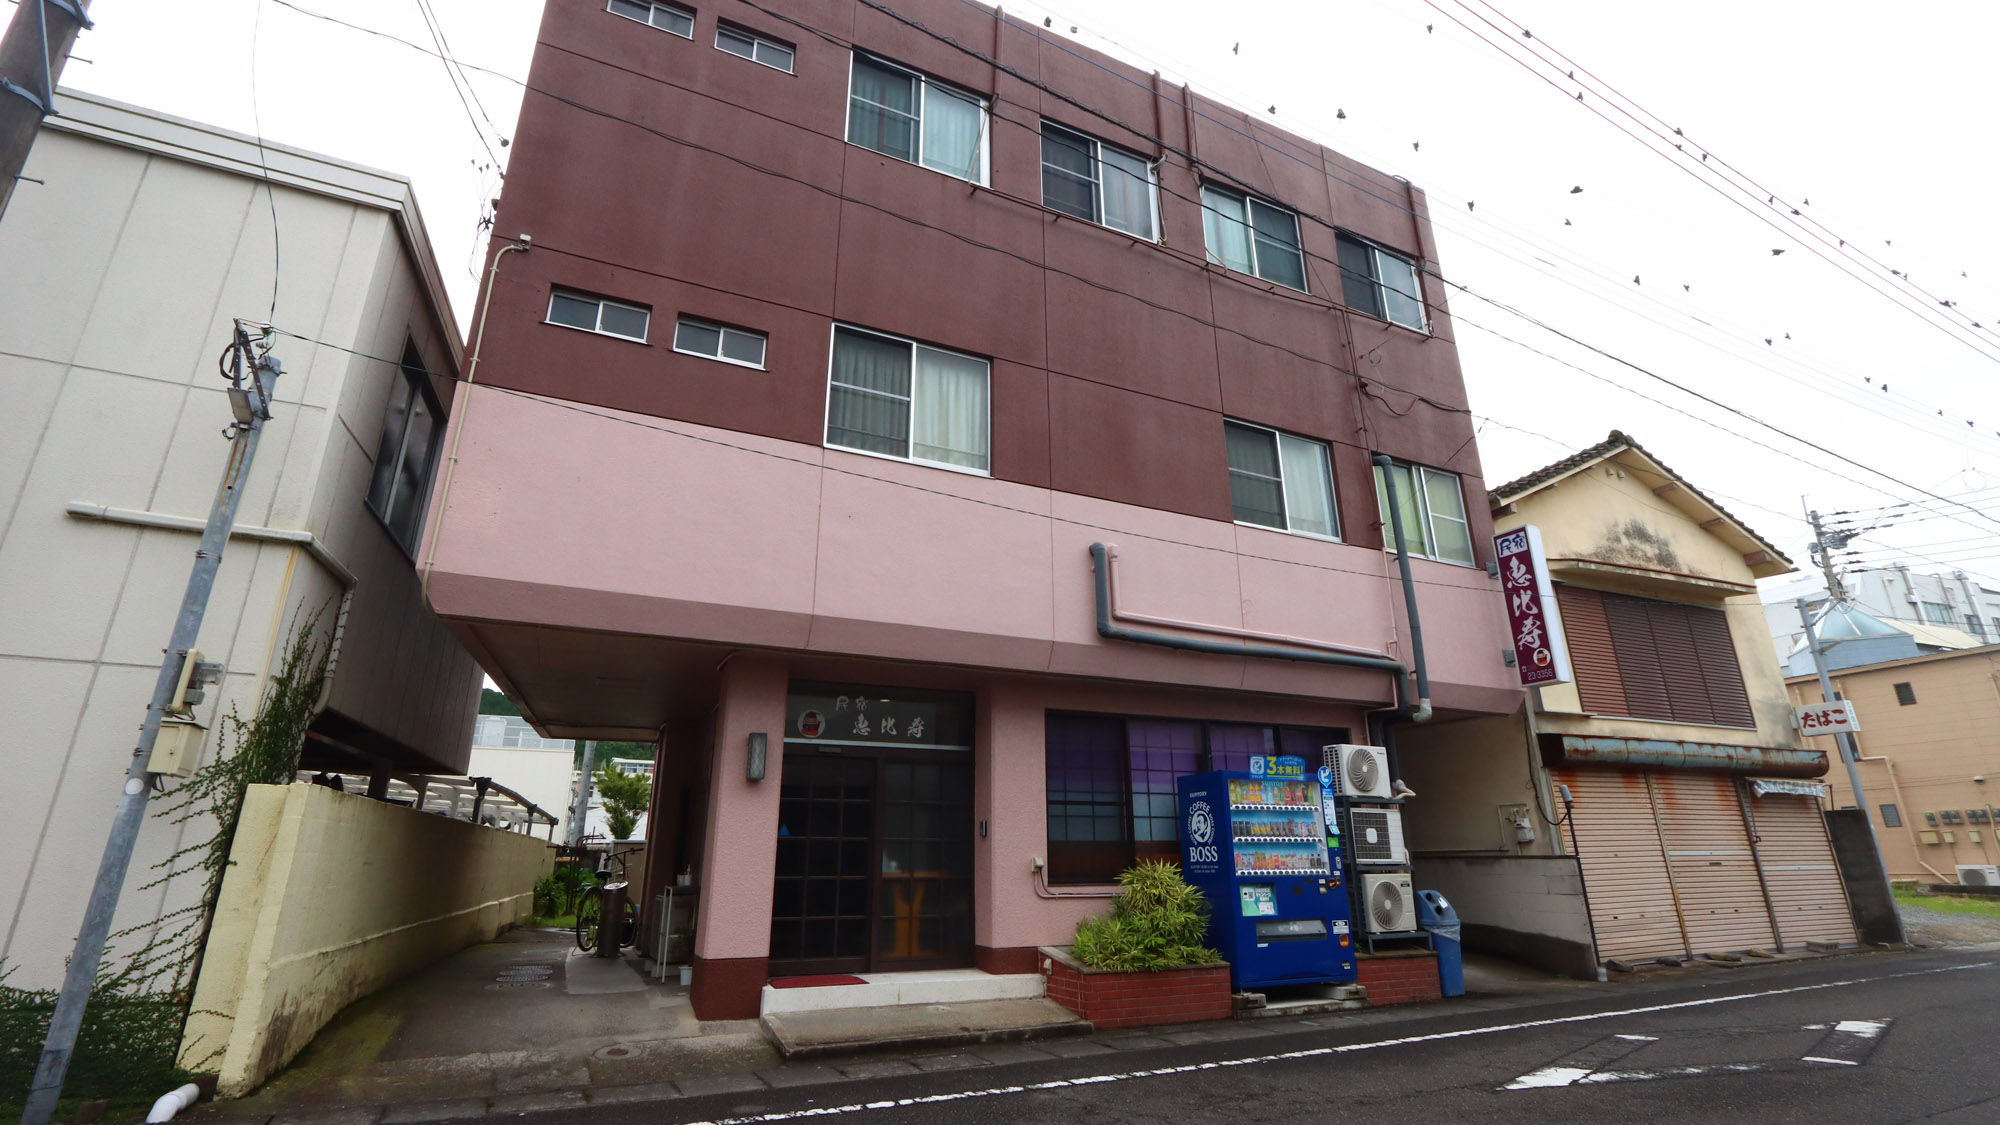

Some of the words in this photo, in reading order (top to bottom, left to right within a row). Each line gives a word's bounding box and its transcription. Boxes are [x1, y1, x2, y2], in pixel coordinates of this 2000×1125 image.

[1500, 533, 1526, 556] 民宿
[1507, 556, 1543, 650] 恵比寿
[835, 695, 869, 712] 民宿
[852, 713, 925, 738] 恵比寿
[1801, 709, 1848, 729] たばこ
[1189, 801, 1211, 815] COFFEE
[1189, 846, 1218, 862] BOSS
